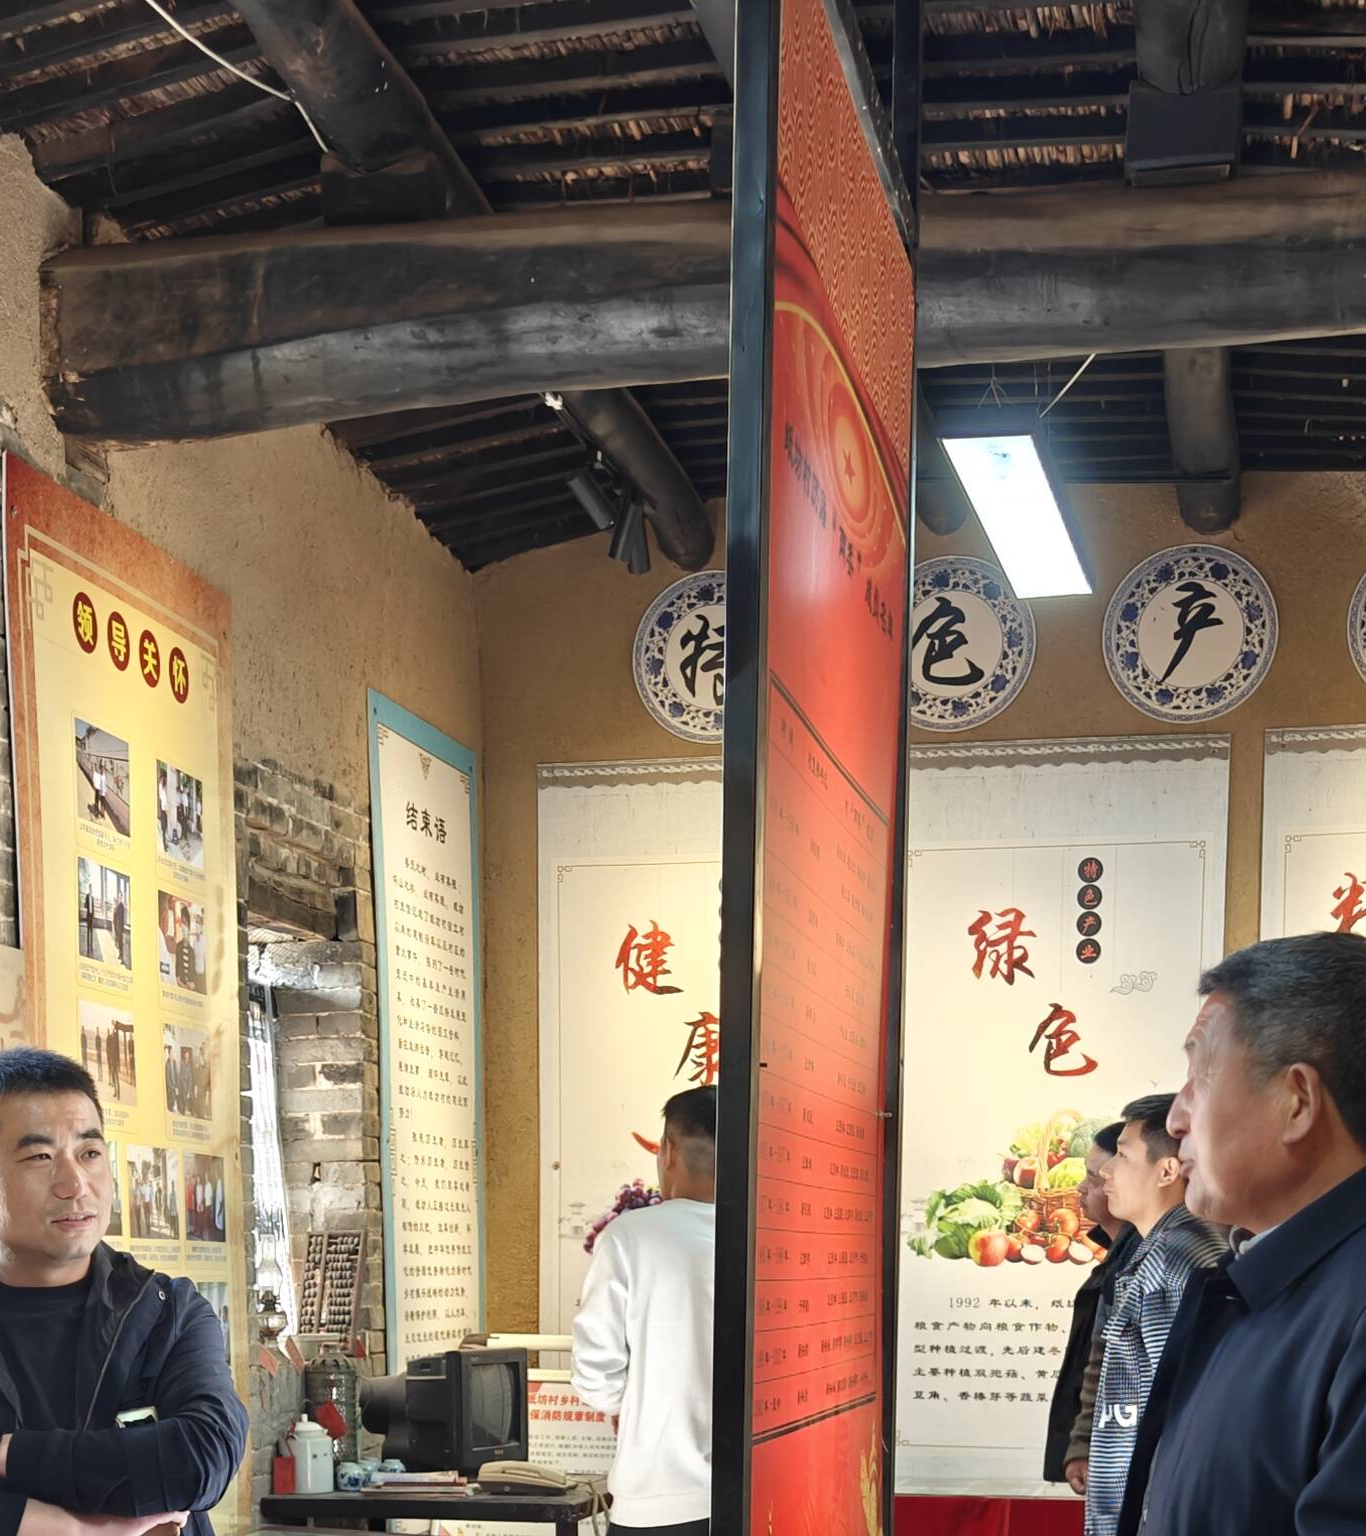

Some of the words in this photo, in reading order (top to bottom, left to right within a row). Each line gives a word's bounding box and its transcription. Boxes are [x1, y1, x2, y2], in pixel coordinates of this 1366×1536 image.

[76, 600, 187, 696] 领导关怀
[406, 800, 447, 845] 结束语
[1081, 859, 1099, 960] 特色产业
[968, 907, 1098, 1077] 绿色
[913, 1345, 1067, 1357] 型种植过渡，先后建冬
